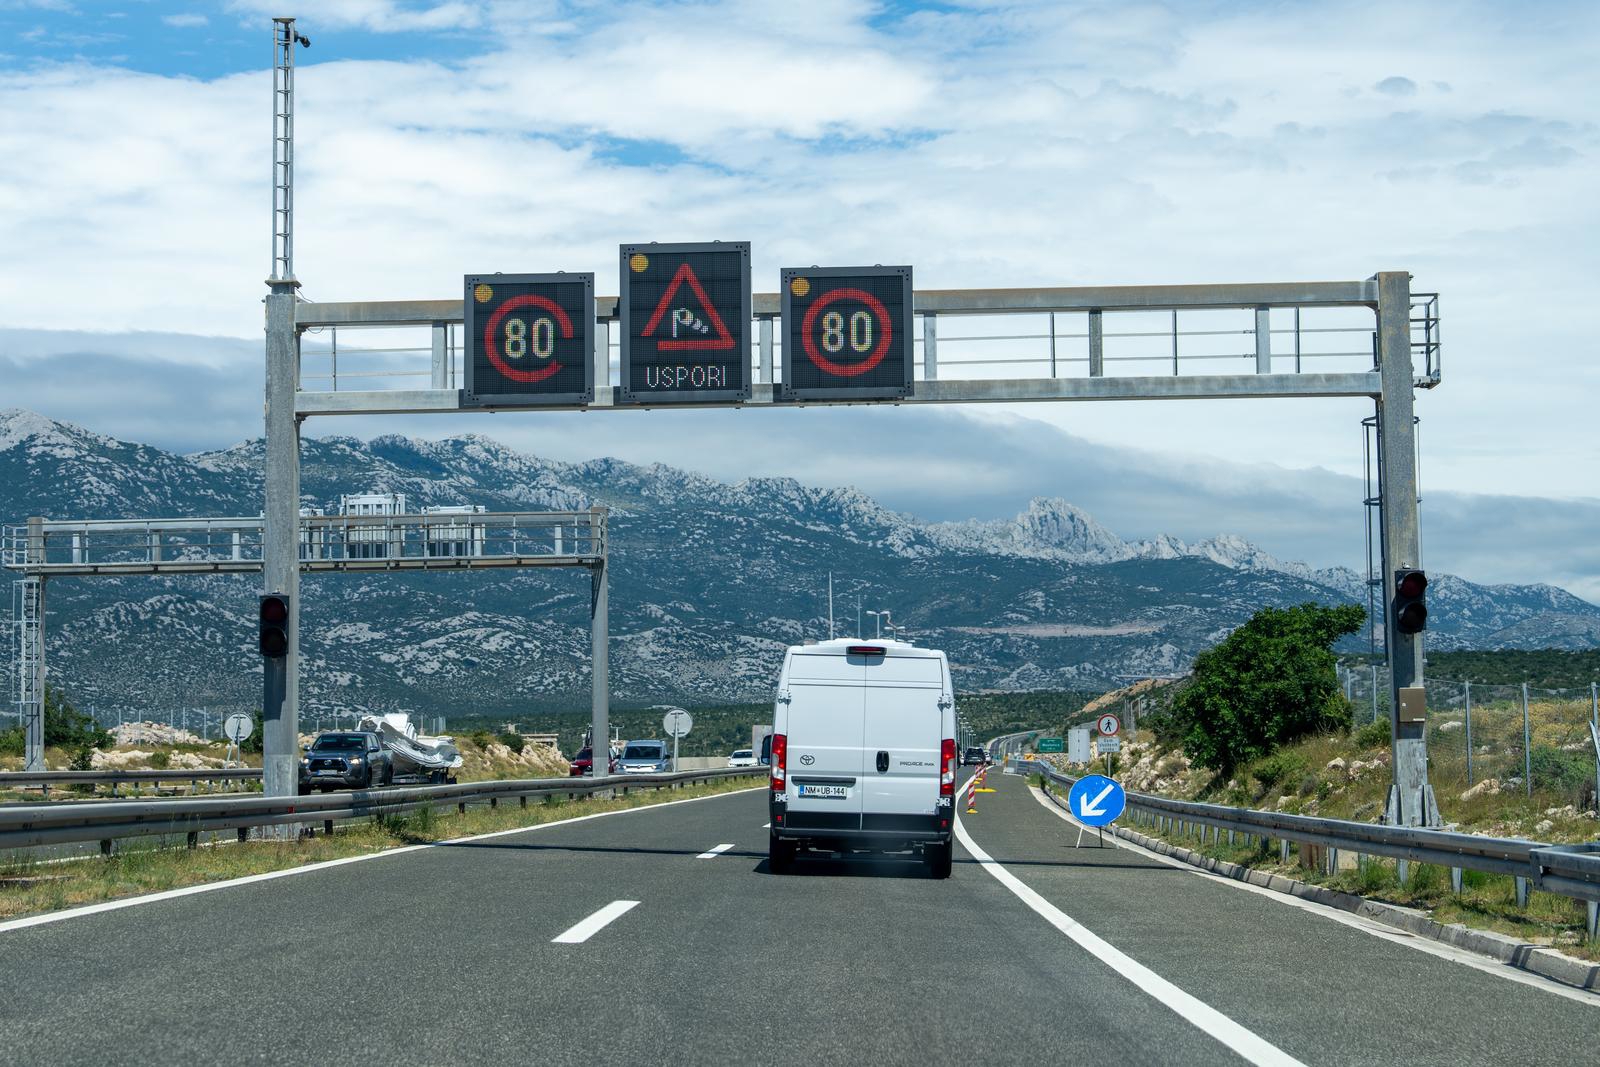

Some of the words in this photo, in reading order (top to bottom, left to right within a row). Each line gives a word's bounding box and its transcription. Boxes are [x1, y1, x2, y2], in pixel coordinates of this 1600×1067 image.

[505, 318, 555, 359] 80
[822, 311, 872, 353] 80
[646, 366, 727, 389] USPORI
